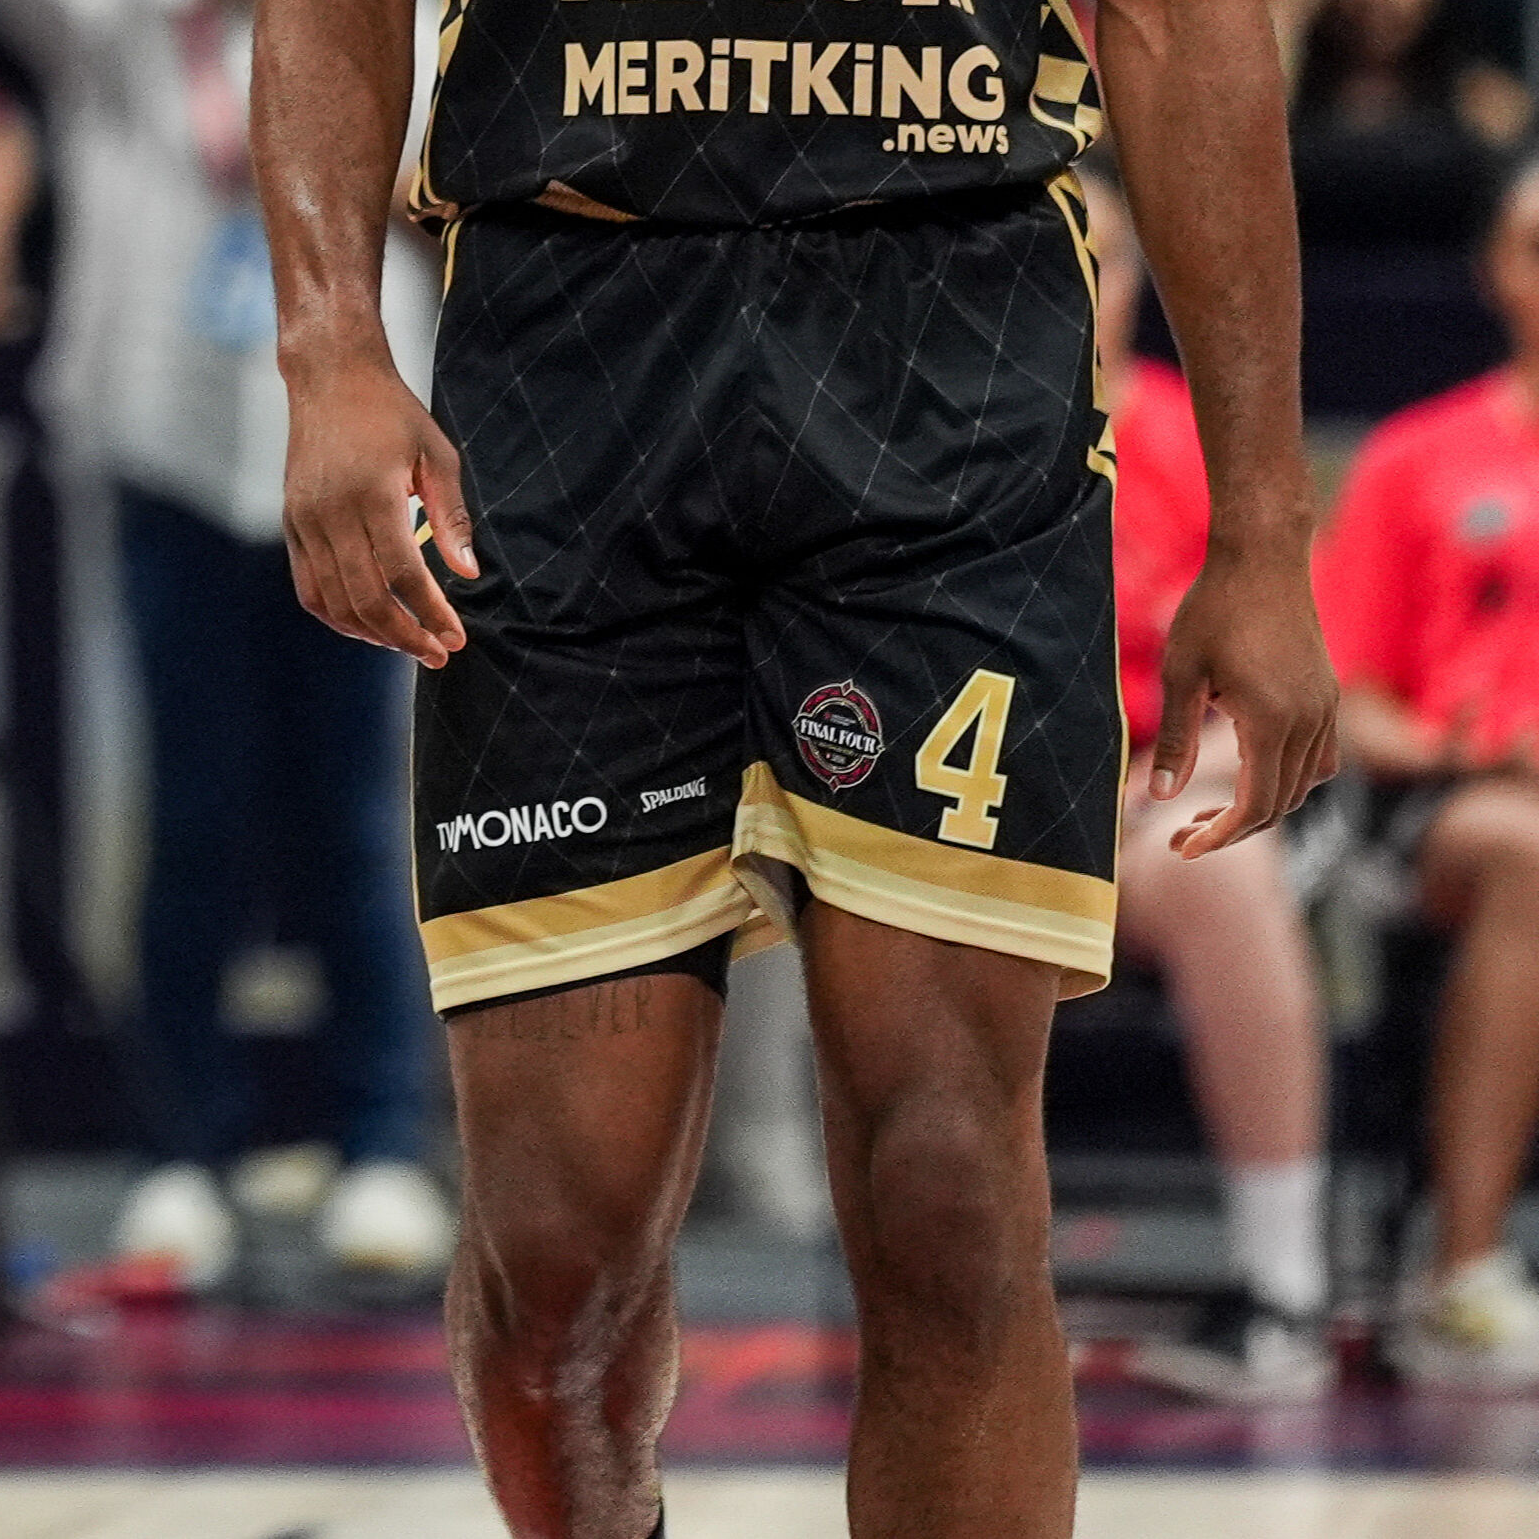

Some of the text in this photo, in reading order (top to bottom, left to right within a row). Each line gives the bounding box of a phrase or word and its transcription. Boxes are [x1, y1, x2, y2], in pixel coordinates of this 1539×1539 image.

[882, 124, 1010, 155] .news
[800, 718, 837, 743] FINAL
[838, 729, 877, 754] FOUR
[915, 667, 1016, 851] 4
[640, 776, 707, 813] SPALDING
